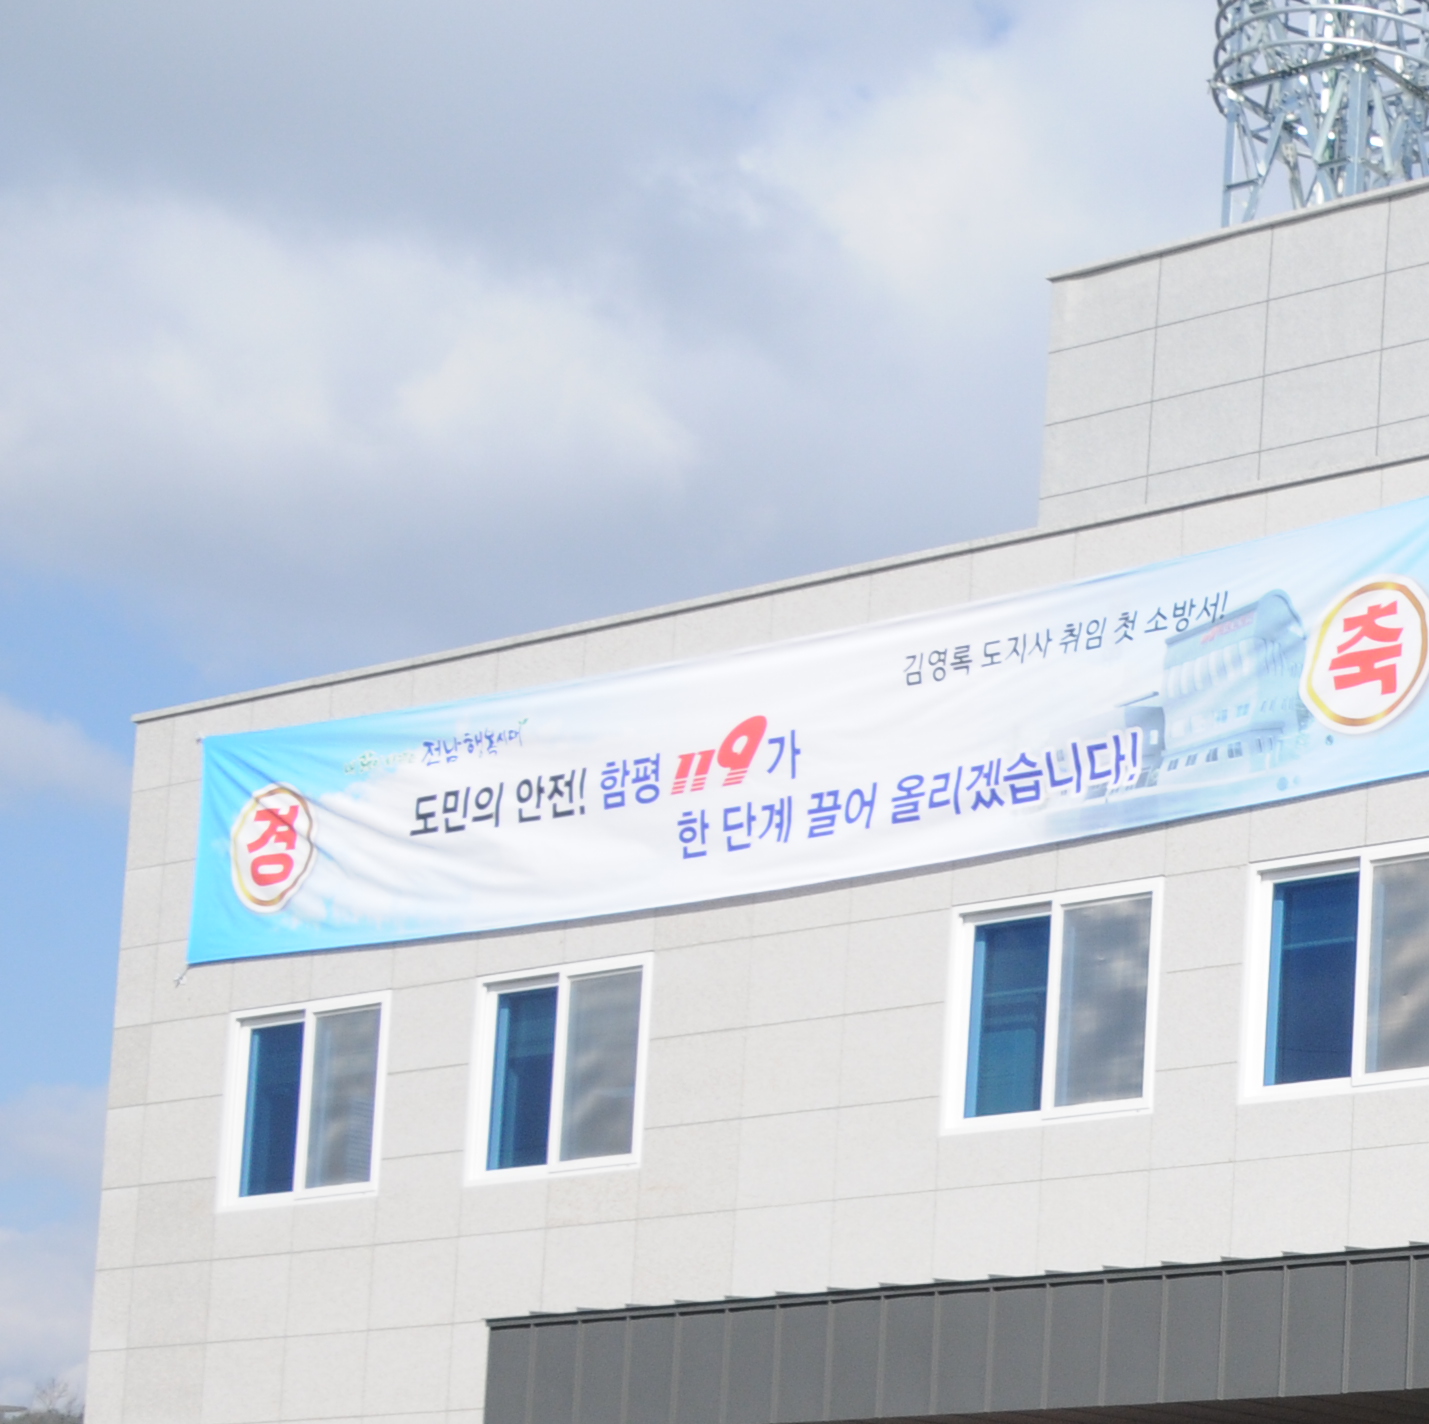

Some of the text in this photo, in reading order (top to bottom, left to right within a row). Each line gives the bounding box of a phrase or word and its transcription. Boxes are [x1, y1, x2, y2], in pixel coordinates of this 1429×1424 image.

[903, 643, 973, 686] 김영록
[981, 629, 1053, 667] 도지사
[1059, 617, 1107, 653] 취임
[1113, 610, 1139, 645] 첫
[1144, 590, 1230, 634] 소방서!
[1328, 600, 1405, 696] 축
[409, 782, 504, 836] 도민의
[515, 767, 587, 823] 안전!
[599, 752, 661, 810] 함평
[677, 731, 1139, 860] 한 단계 끌어 올리겠습니다!
[246, 804, 300, 887] 경
